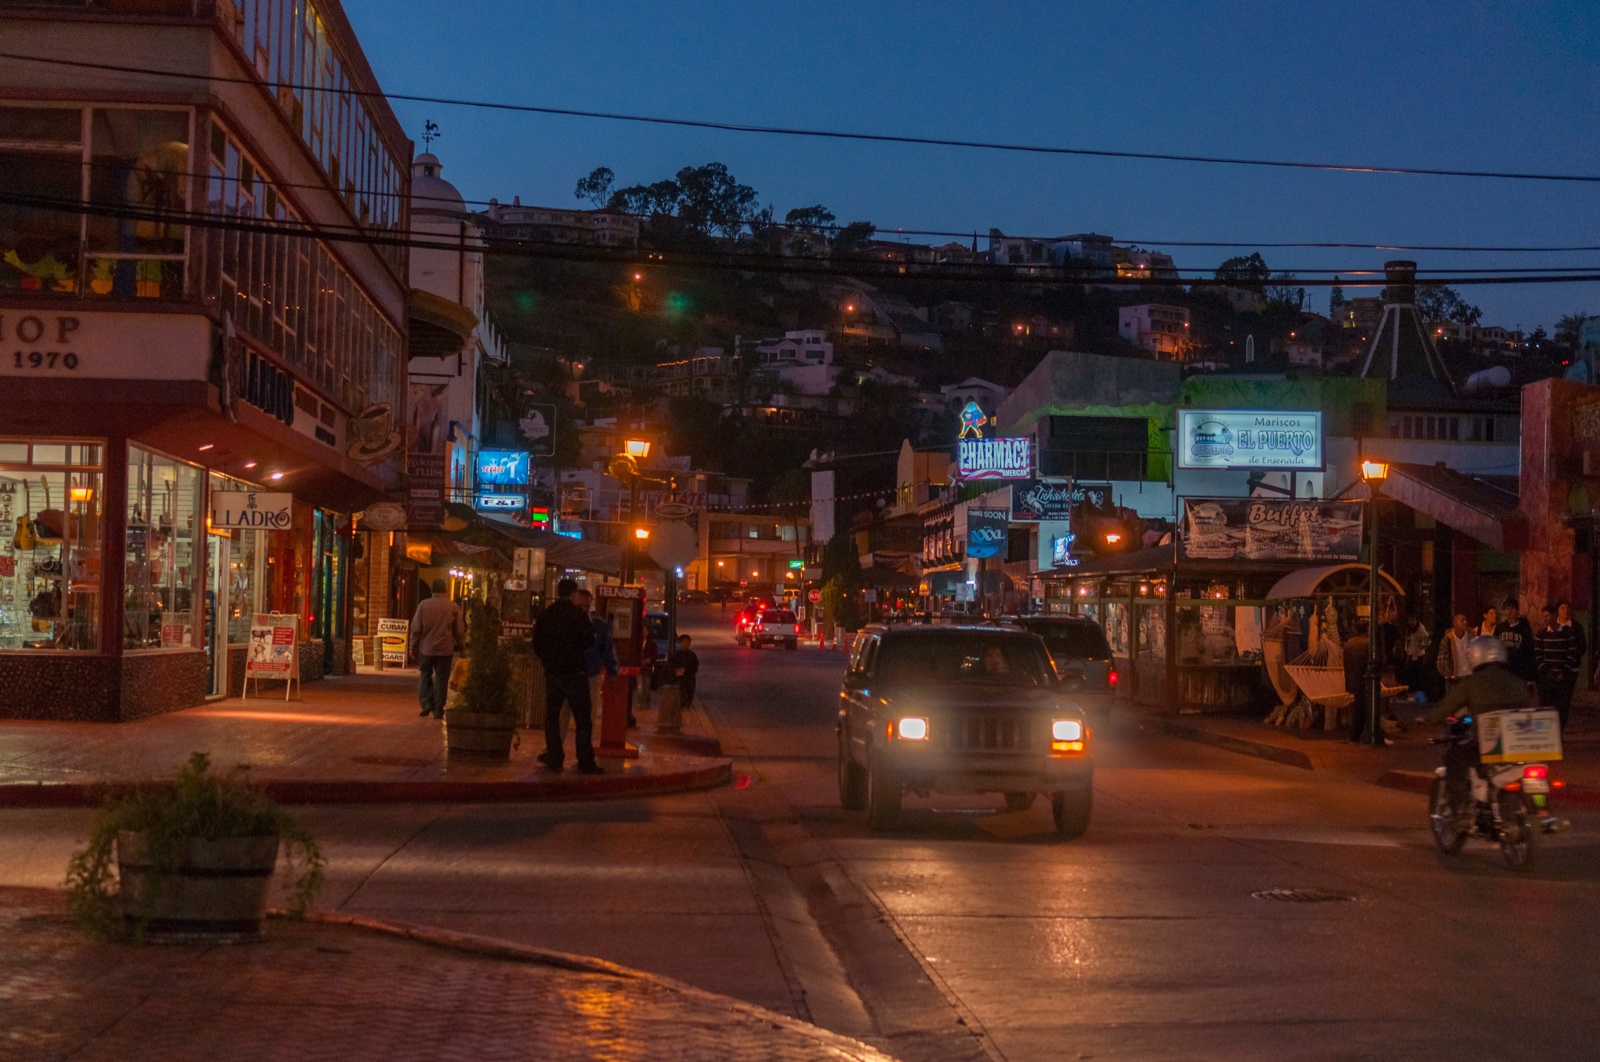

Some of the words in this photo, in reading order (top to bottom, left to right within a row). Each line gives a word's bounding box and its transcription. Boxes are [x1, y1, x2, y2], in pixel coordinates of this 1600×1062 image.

[0, 315, 80, 343] OP
[13, 351, 79, 370] 1970
[1254, 417, 1301, 427] Mariscos
[1237, 429, 1256, 450] EL
[1257, 429, 1314, 457] PUERTO
[959, 440, 1029, 470] PHARMACY
[1248, 456, 1260, 464] de
[1261, 456, 1306, 465] Ensenada
[1002, 469, 1027, 477] AMERICAN
[212, 507, 290, 529] LLADRÓ
[984, 511, 1006, 521] SOON
[1248, 503, 1320, 527] Buffet
[598, 586, 640, 599] TELNOR
[380, 623, 407, 631] CUBAN
